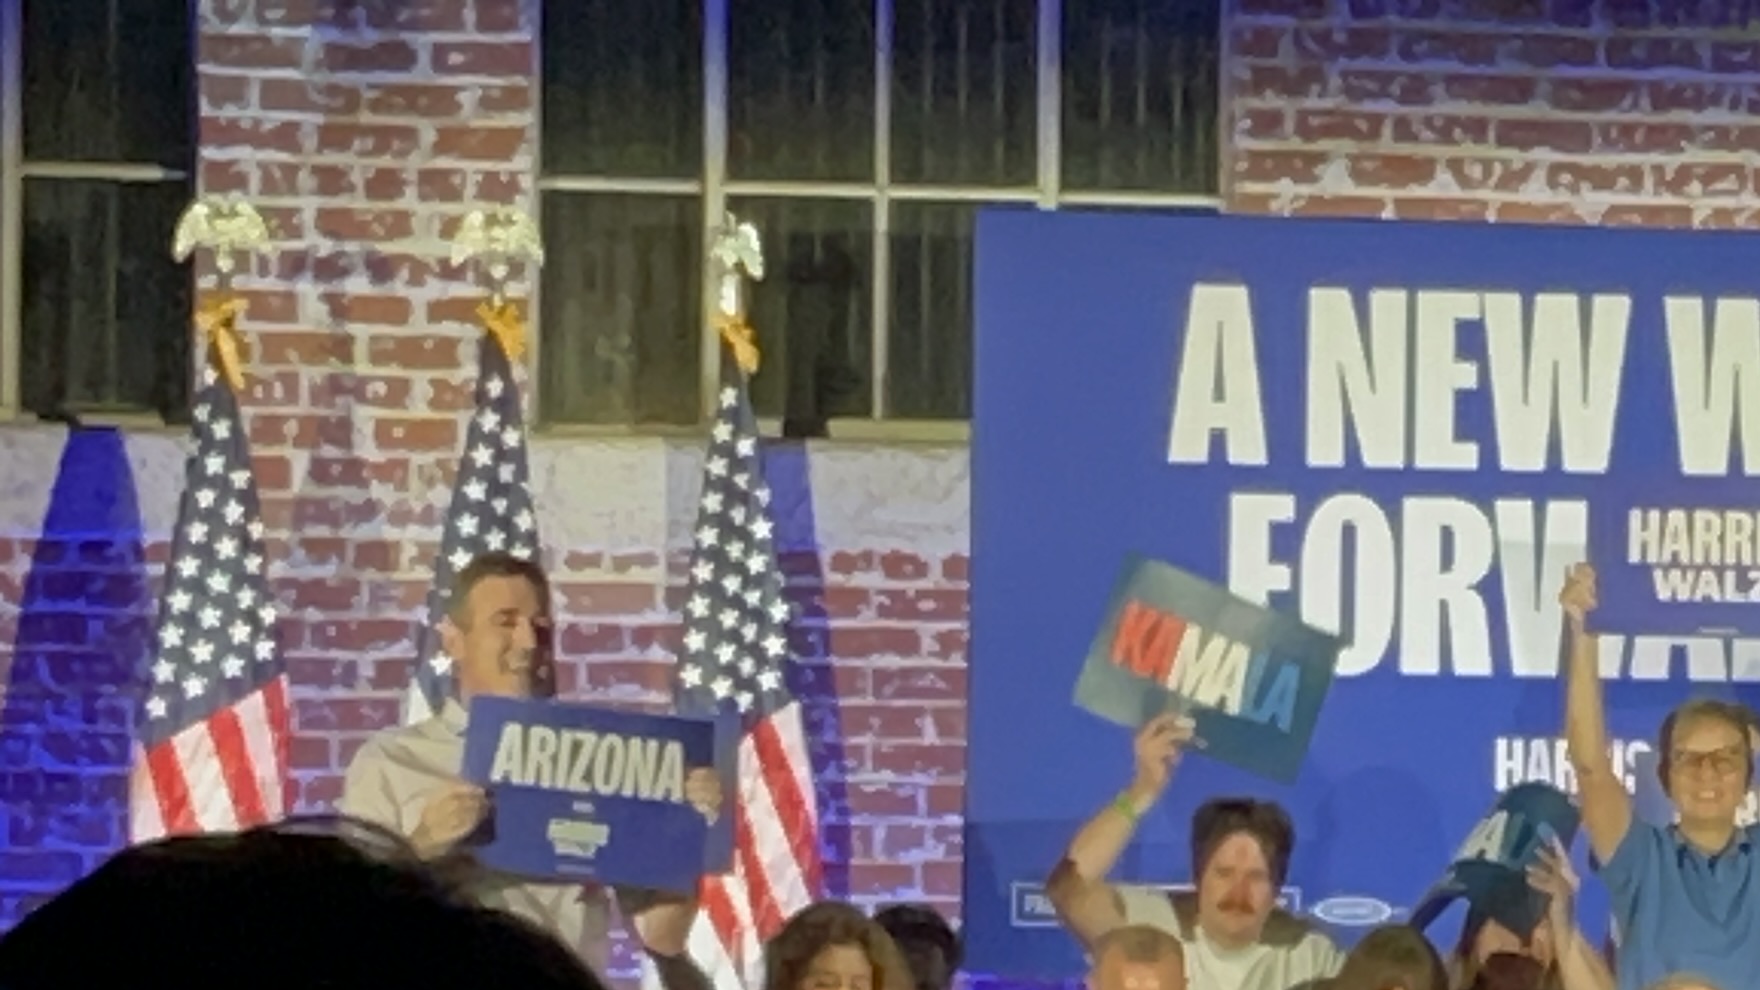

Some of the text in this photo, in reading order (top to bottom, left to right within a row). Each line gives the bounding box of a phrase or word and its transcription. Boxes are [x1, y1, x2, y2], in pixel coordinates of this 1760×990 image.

[1167, 283, 1269, 464] A
[1305, 286, 1632, 473] NEW
[1110, 598, 1302, 734] KAMALA
[491, 721, 685, 803] ARIZONA
